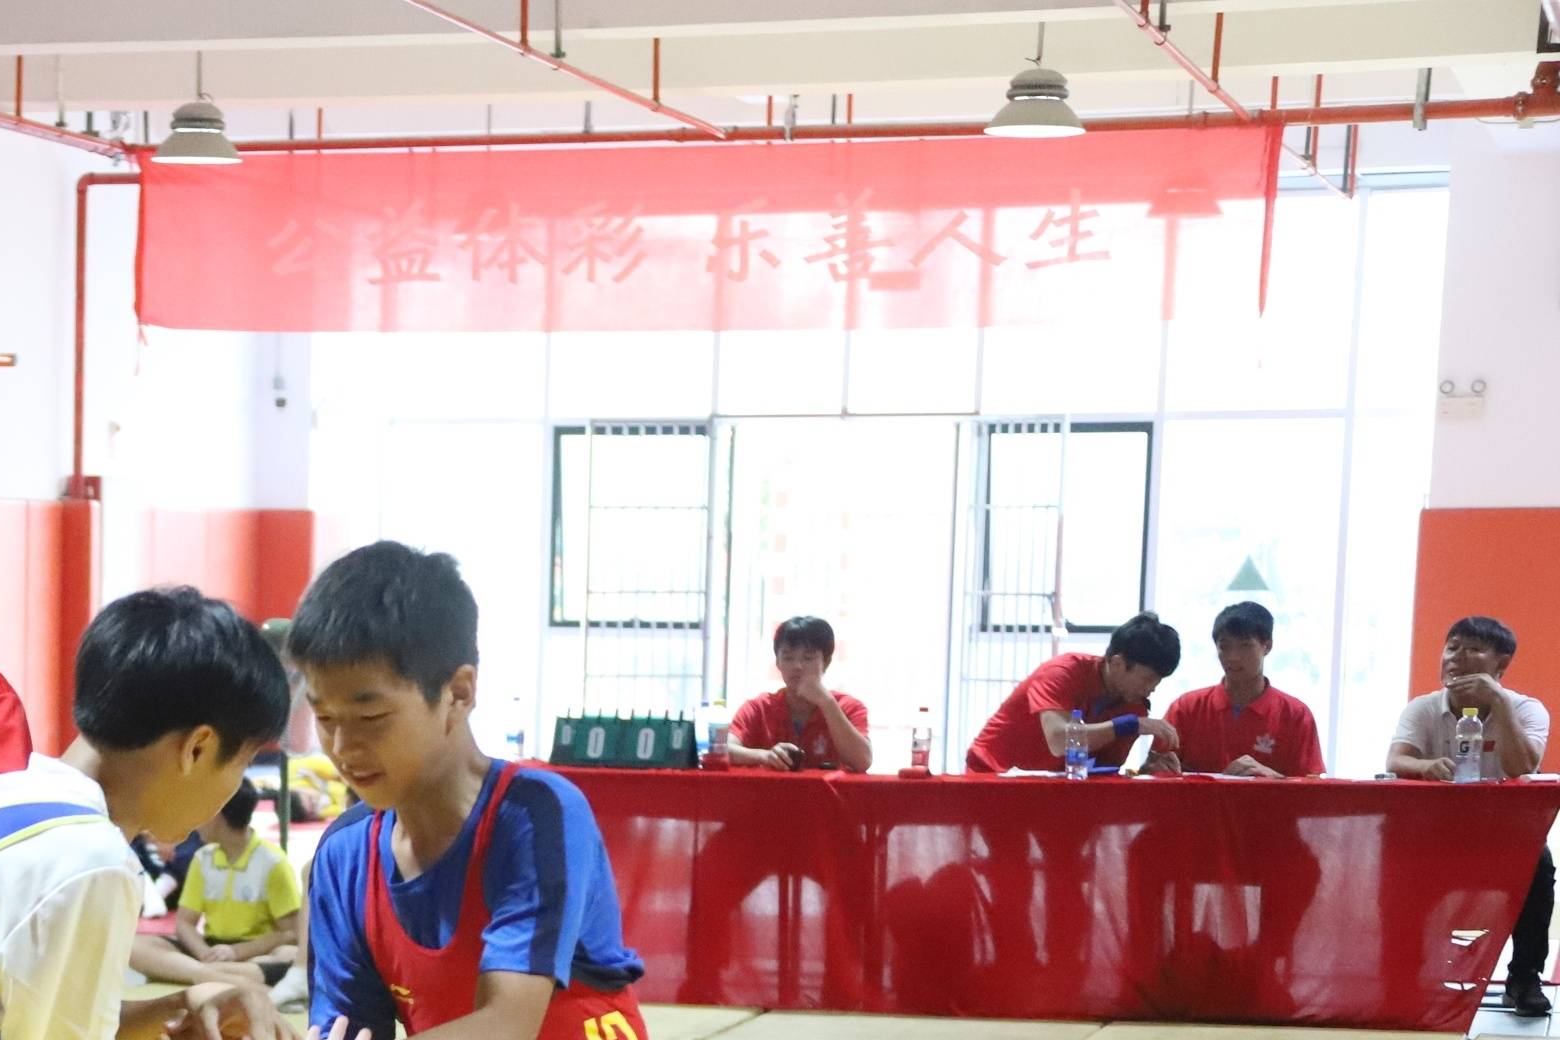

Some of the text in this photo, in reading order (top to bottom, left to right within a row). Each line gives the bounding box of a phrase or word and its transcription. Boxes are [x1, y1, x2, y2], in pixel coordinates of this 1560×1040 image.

[266, 187, 1113, 286] 公益体彩 乐善人生
[587, 727, 605, 759] 0
[637, 727, 655, 760] 0
